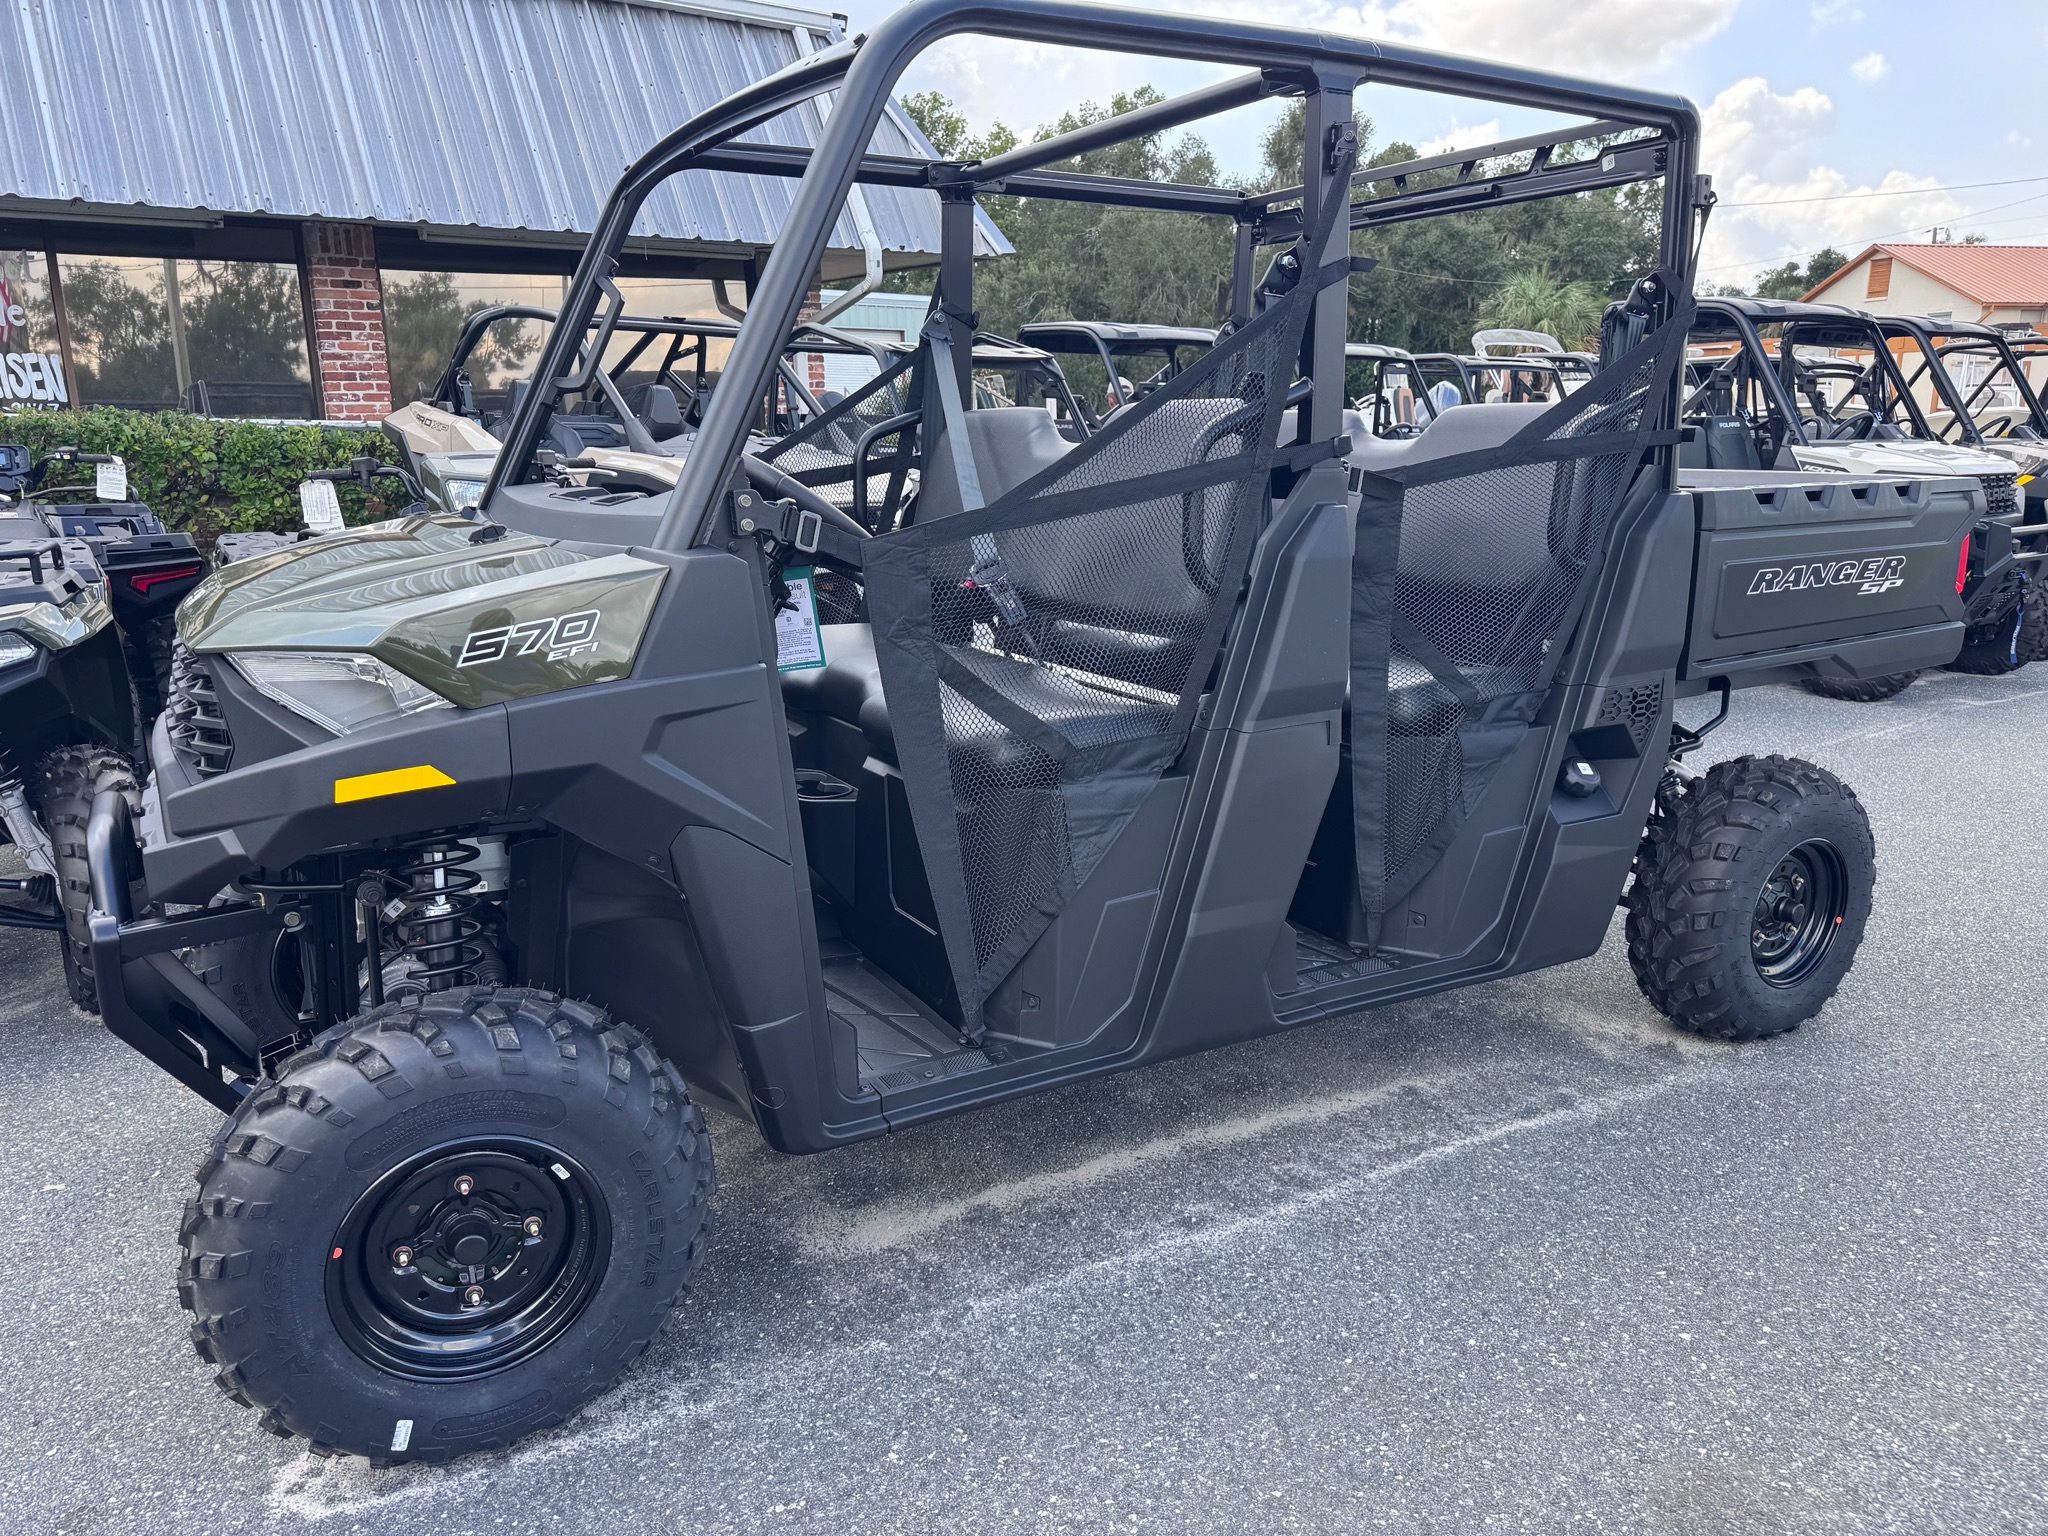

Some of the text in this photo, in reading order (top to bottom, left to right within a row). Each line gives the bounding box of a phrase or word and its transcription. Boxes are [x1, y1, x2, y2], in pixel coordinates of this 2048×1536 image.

[1747, 555, 1907, 595] RANGER
[1857, 579, 1905, 596] SP
[456, 608, 602, 669] 570
[546, 641, 600, 662] EFI
[384, 1122, 405, 1138] NOT
[408, 1112, 429, 1125] FOR
[483, 1100, 526, 1108] SERVICE
[627, 1149, 667, 1289] CARLSTAR
